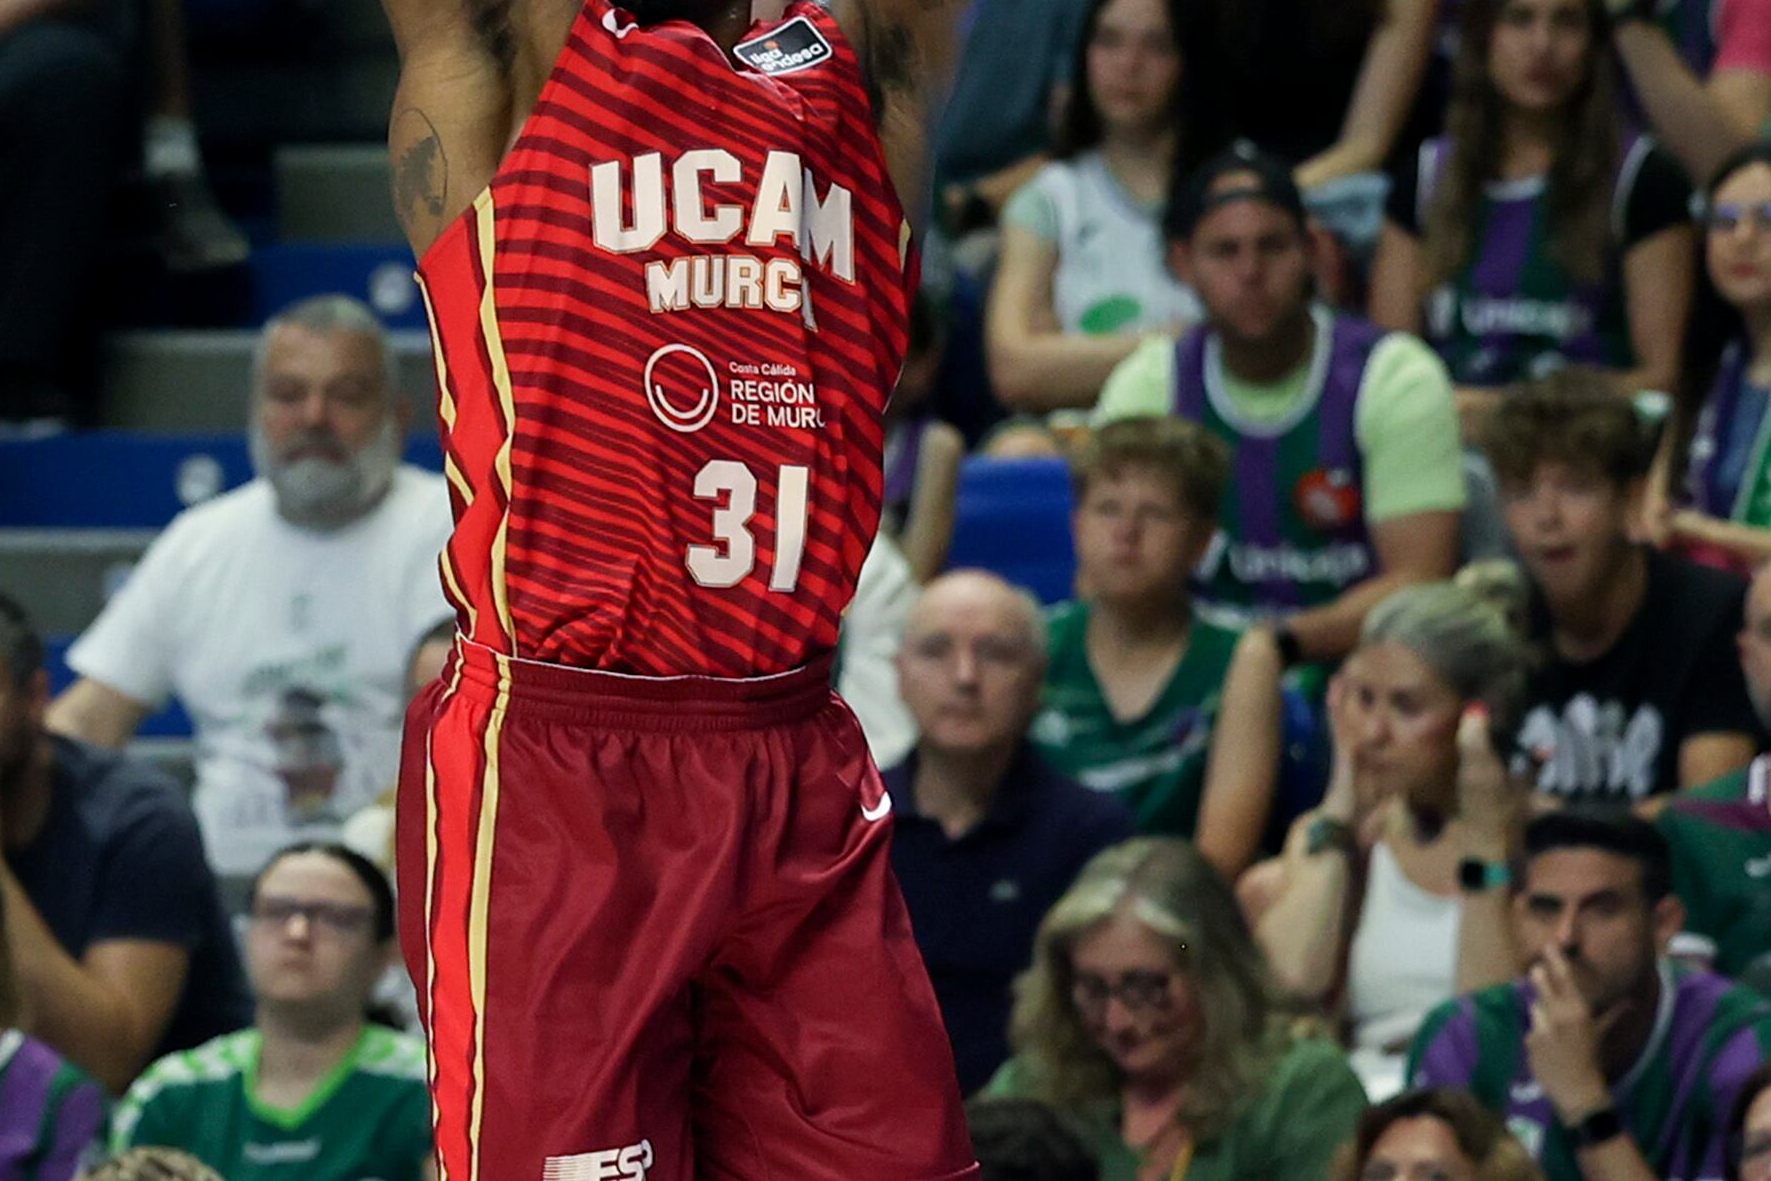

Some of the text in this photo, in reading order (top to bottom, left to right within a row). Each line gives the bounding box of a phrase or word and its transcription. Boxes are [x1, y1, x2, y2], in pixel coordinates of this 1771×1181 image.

[589, 148, 856, 285] UCAM
[729, 361, 759, 375] Costa
[730, 378, 815, 405] REGIÓN
[732, 403, 760, 425] DE
[685, 459, 809, 593] 31
